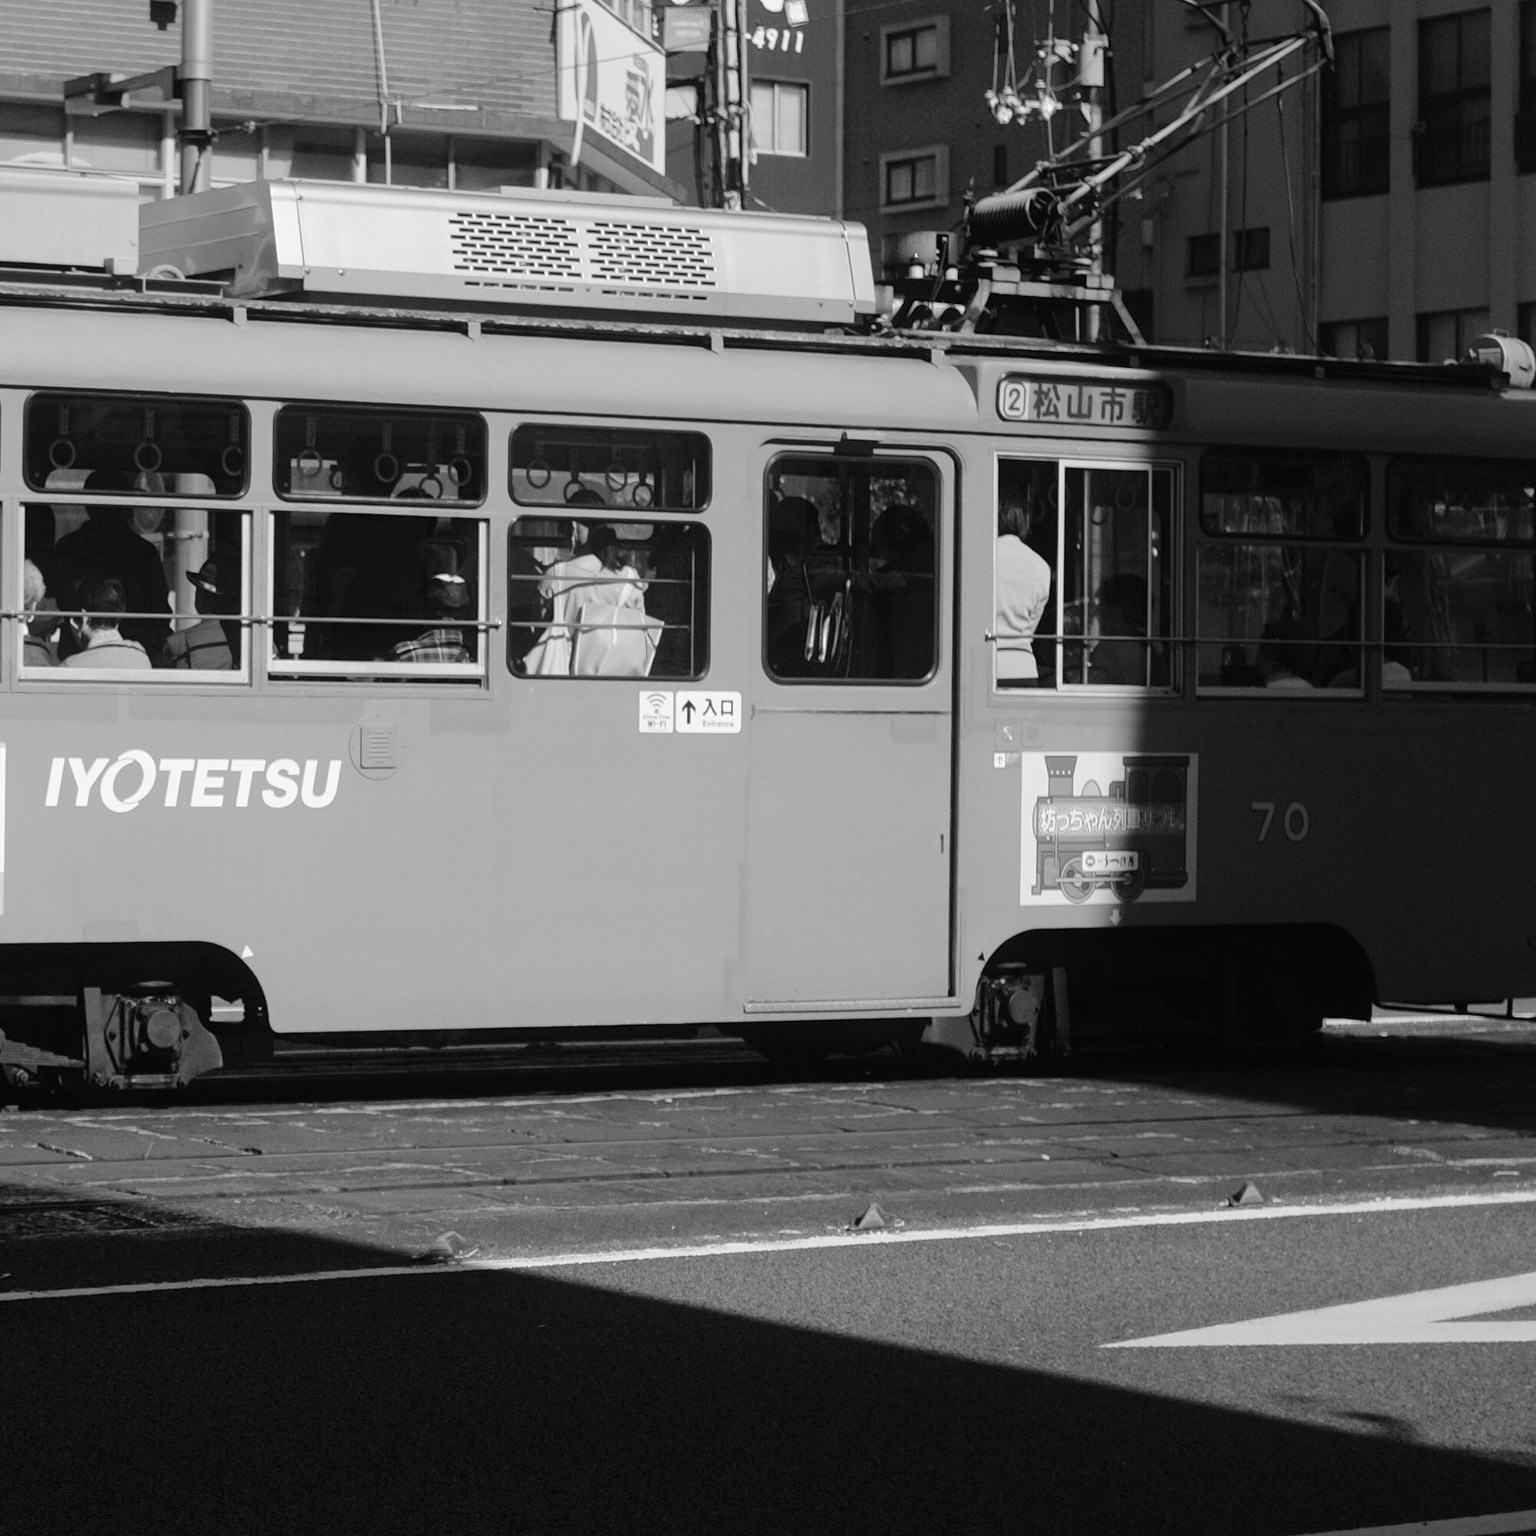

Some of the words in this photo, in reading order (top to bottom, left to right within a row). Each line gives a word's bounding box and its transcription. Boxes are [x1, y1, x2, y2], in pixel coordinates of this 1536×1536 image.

[1008, 388, 1021, 411] 2
[703, 698, 733, 716] 入口
[647, 720, 667, 728] Wi-Fi
[45, 749, 342, 813] IYOTETSU
[1251, 801, 1309, 843] 70
